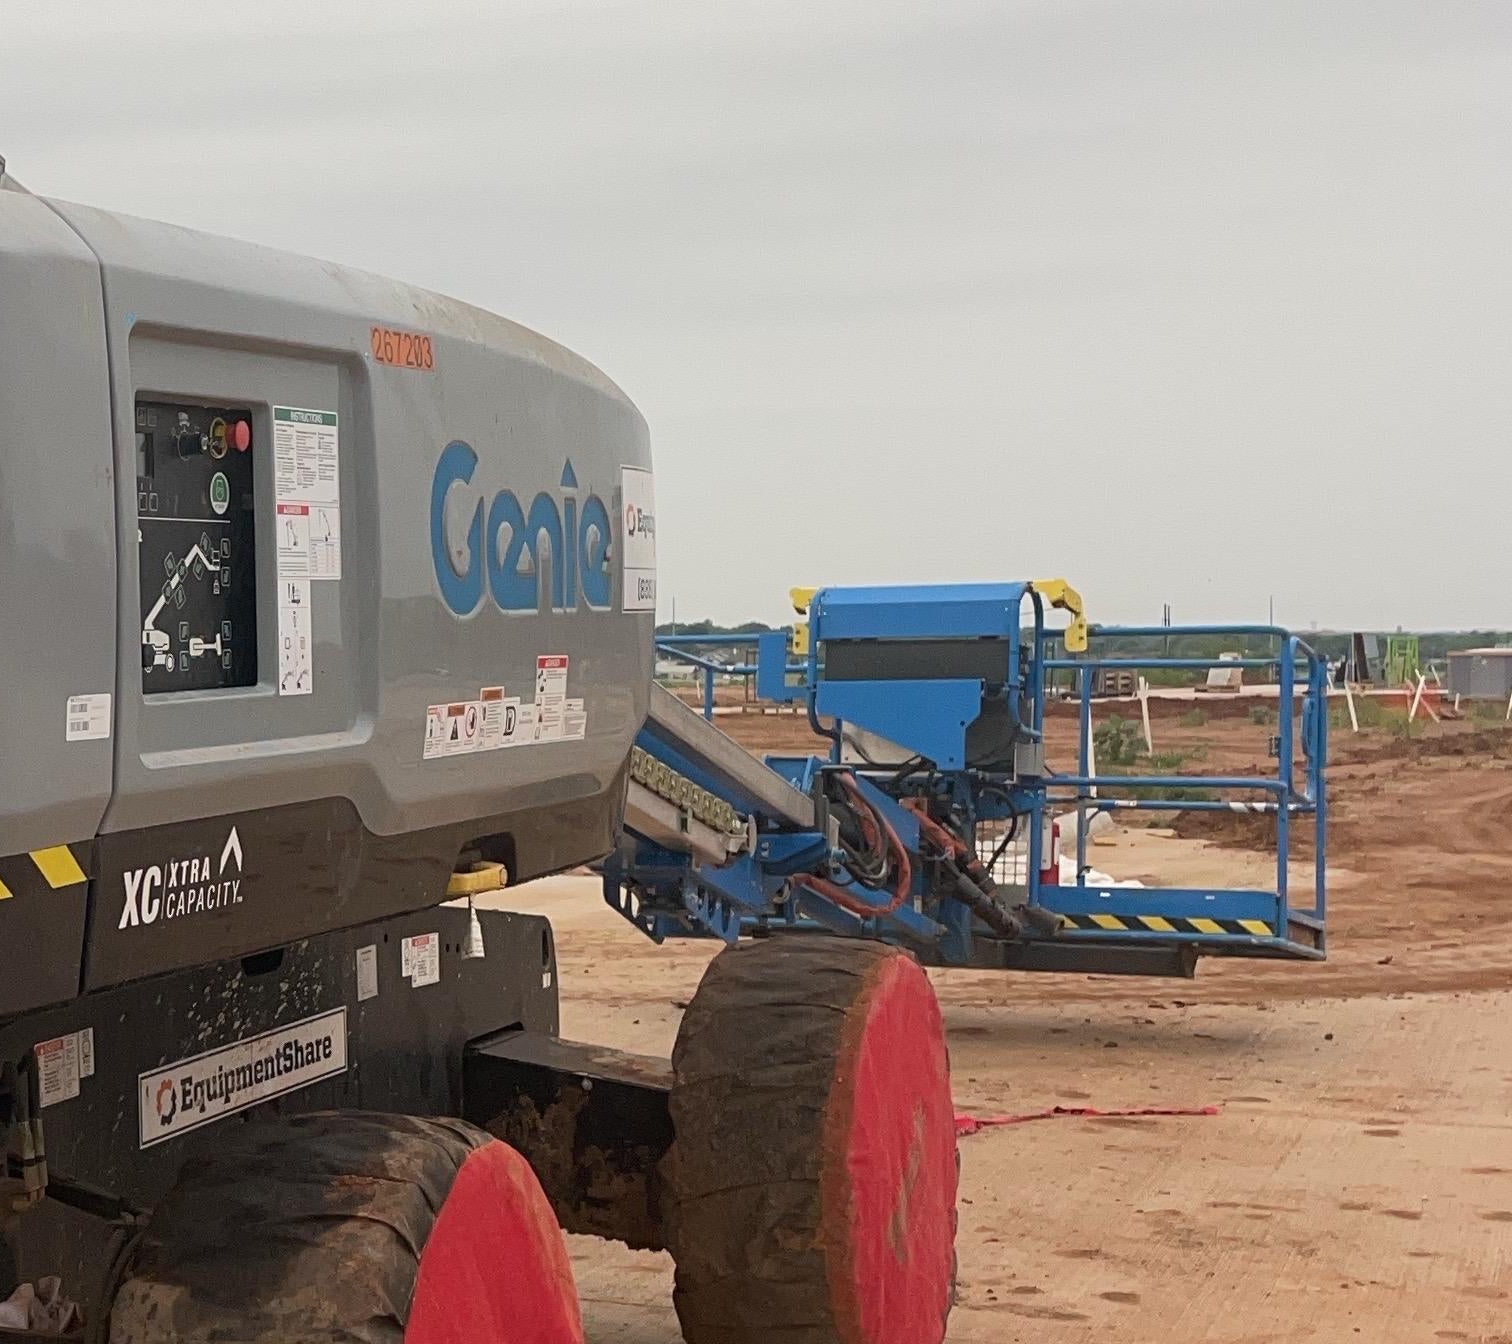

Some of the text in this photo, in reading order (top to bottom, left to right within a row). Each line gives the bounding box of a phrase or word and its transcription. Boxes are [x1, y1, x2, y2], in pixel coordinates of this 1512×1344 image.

[372, 327, 433, 369] 267203
[430, 439, 612, 618] Genie
[117, 864, 163, 930] XC
[168, 856, 211, 888] XTRA
[180, 1035, 332, 1114] EquipmentShare
